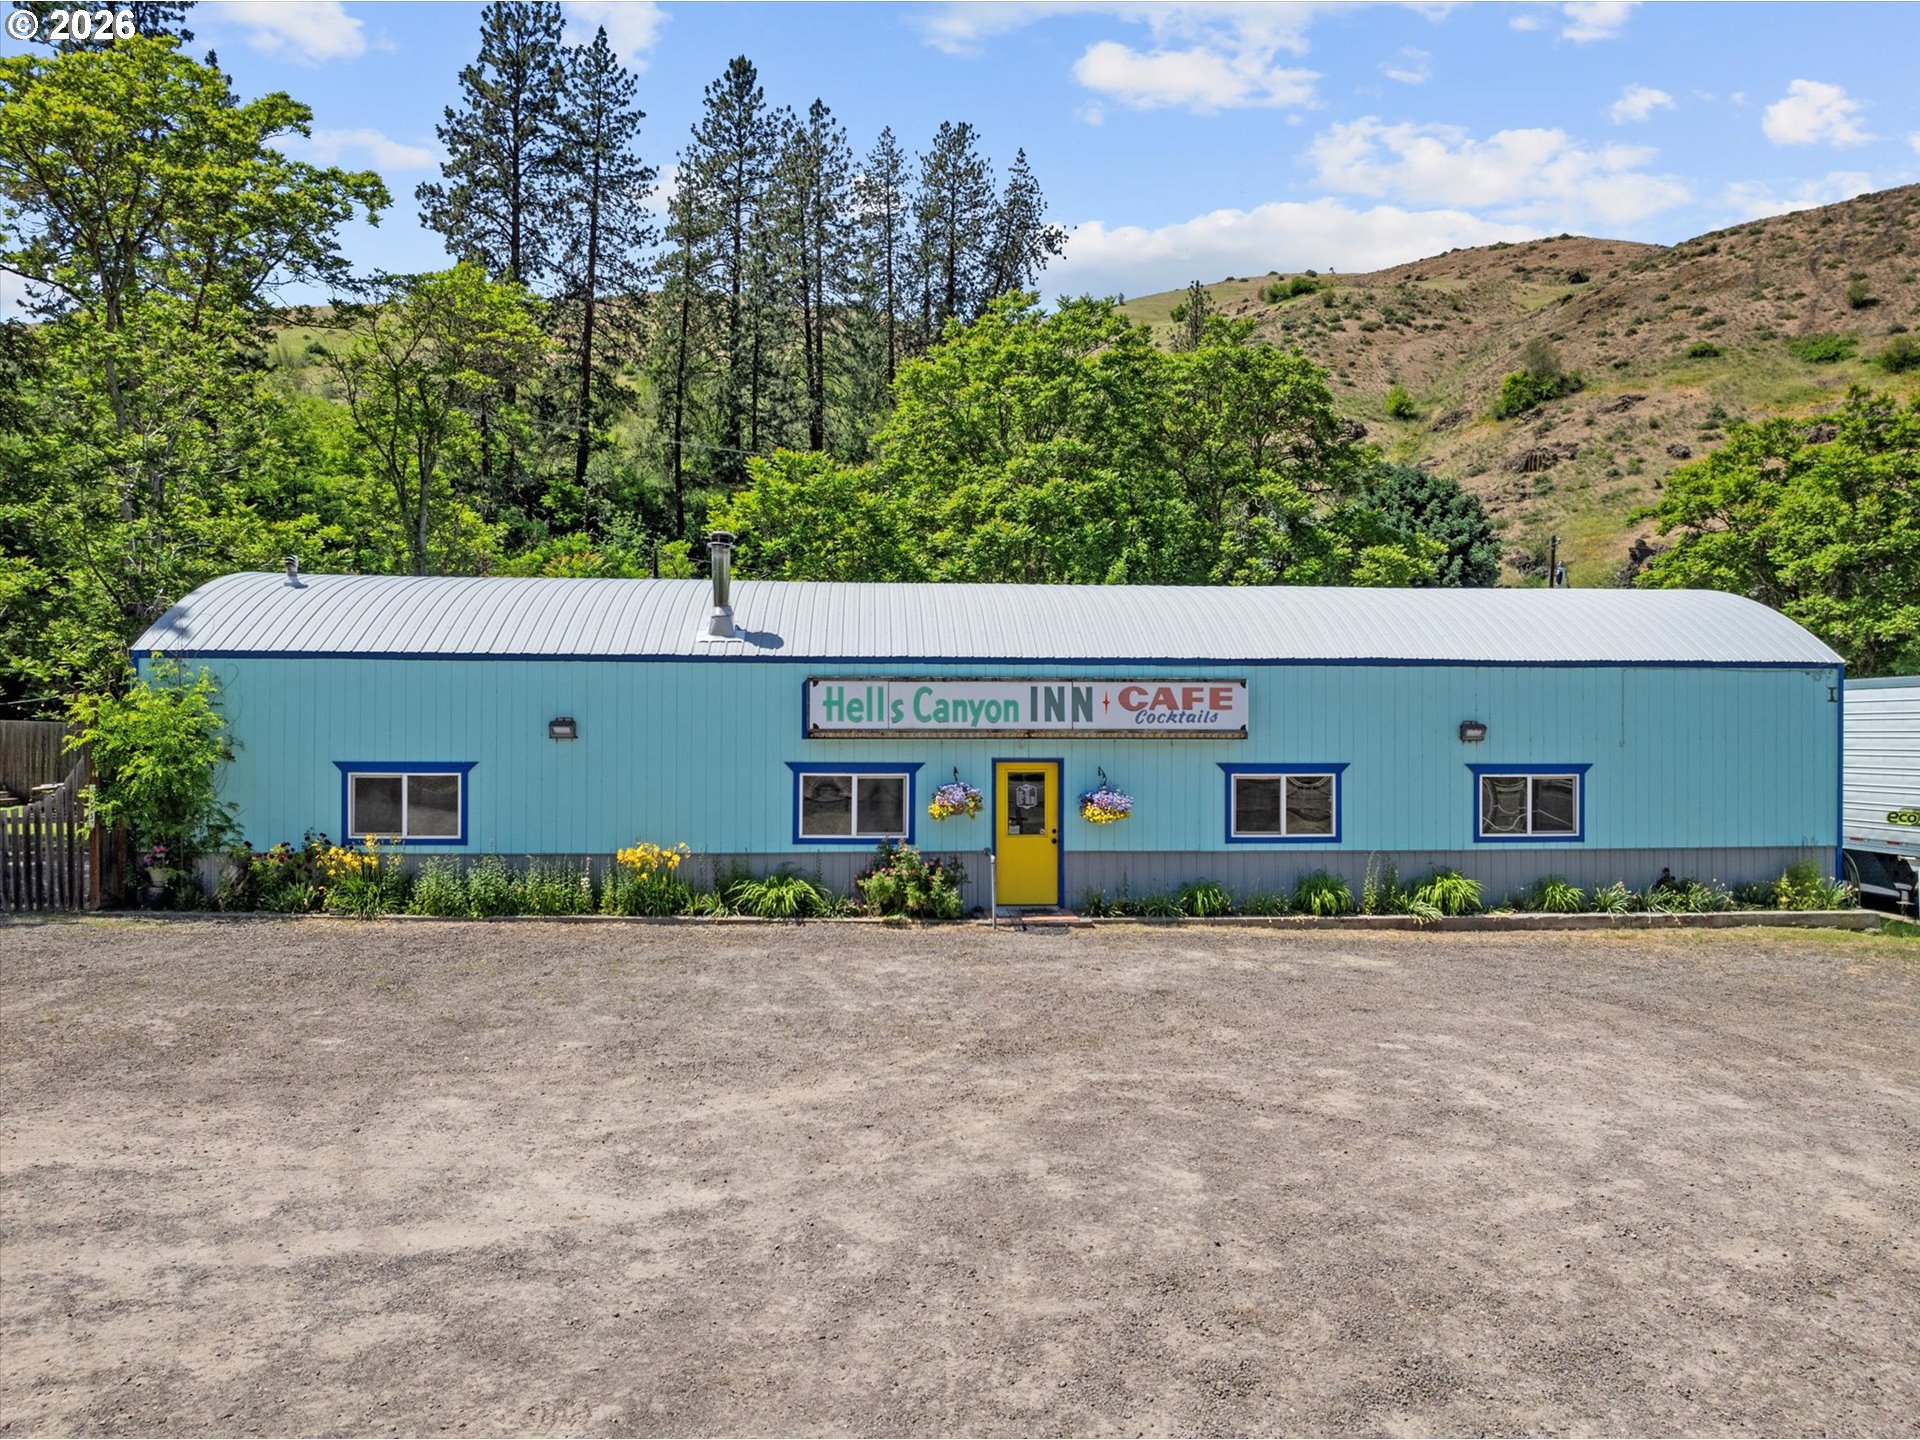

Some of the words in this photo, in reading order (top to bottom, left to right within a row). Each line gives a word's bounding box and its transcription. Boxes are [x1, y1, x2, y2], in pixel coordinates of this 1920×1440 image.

[913, 686, 1019, 727] Canyon
[1030, 686, 1093, 722] INN
[1118, 685, 1233, 712] CAFE
[1135, 709, 1219, 724] Cocktails
